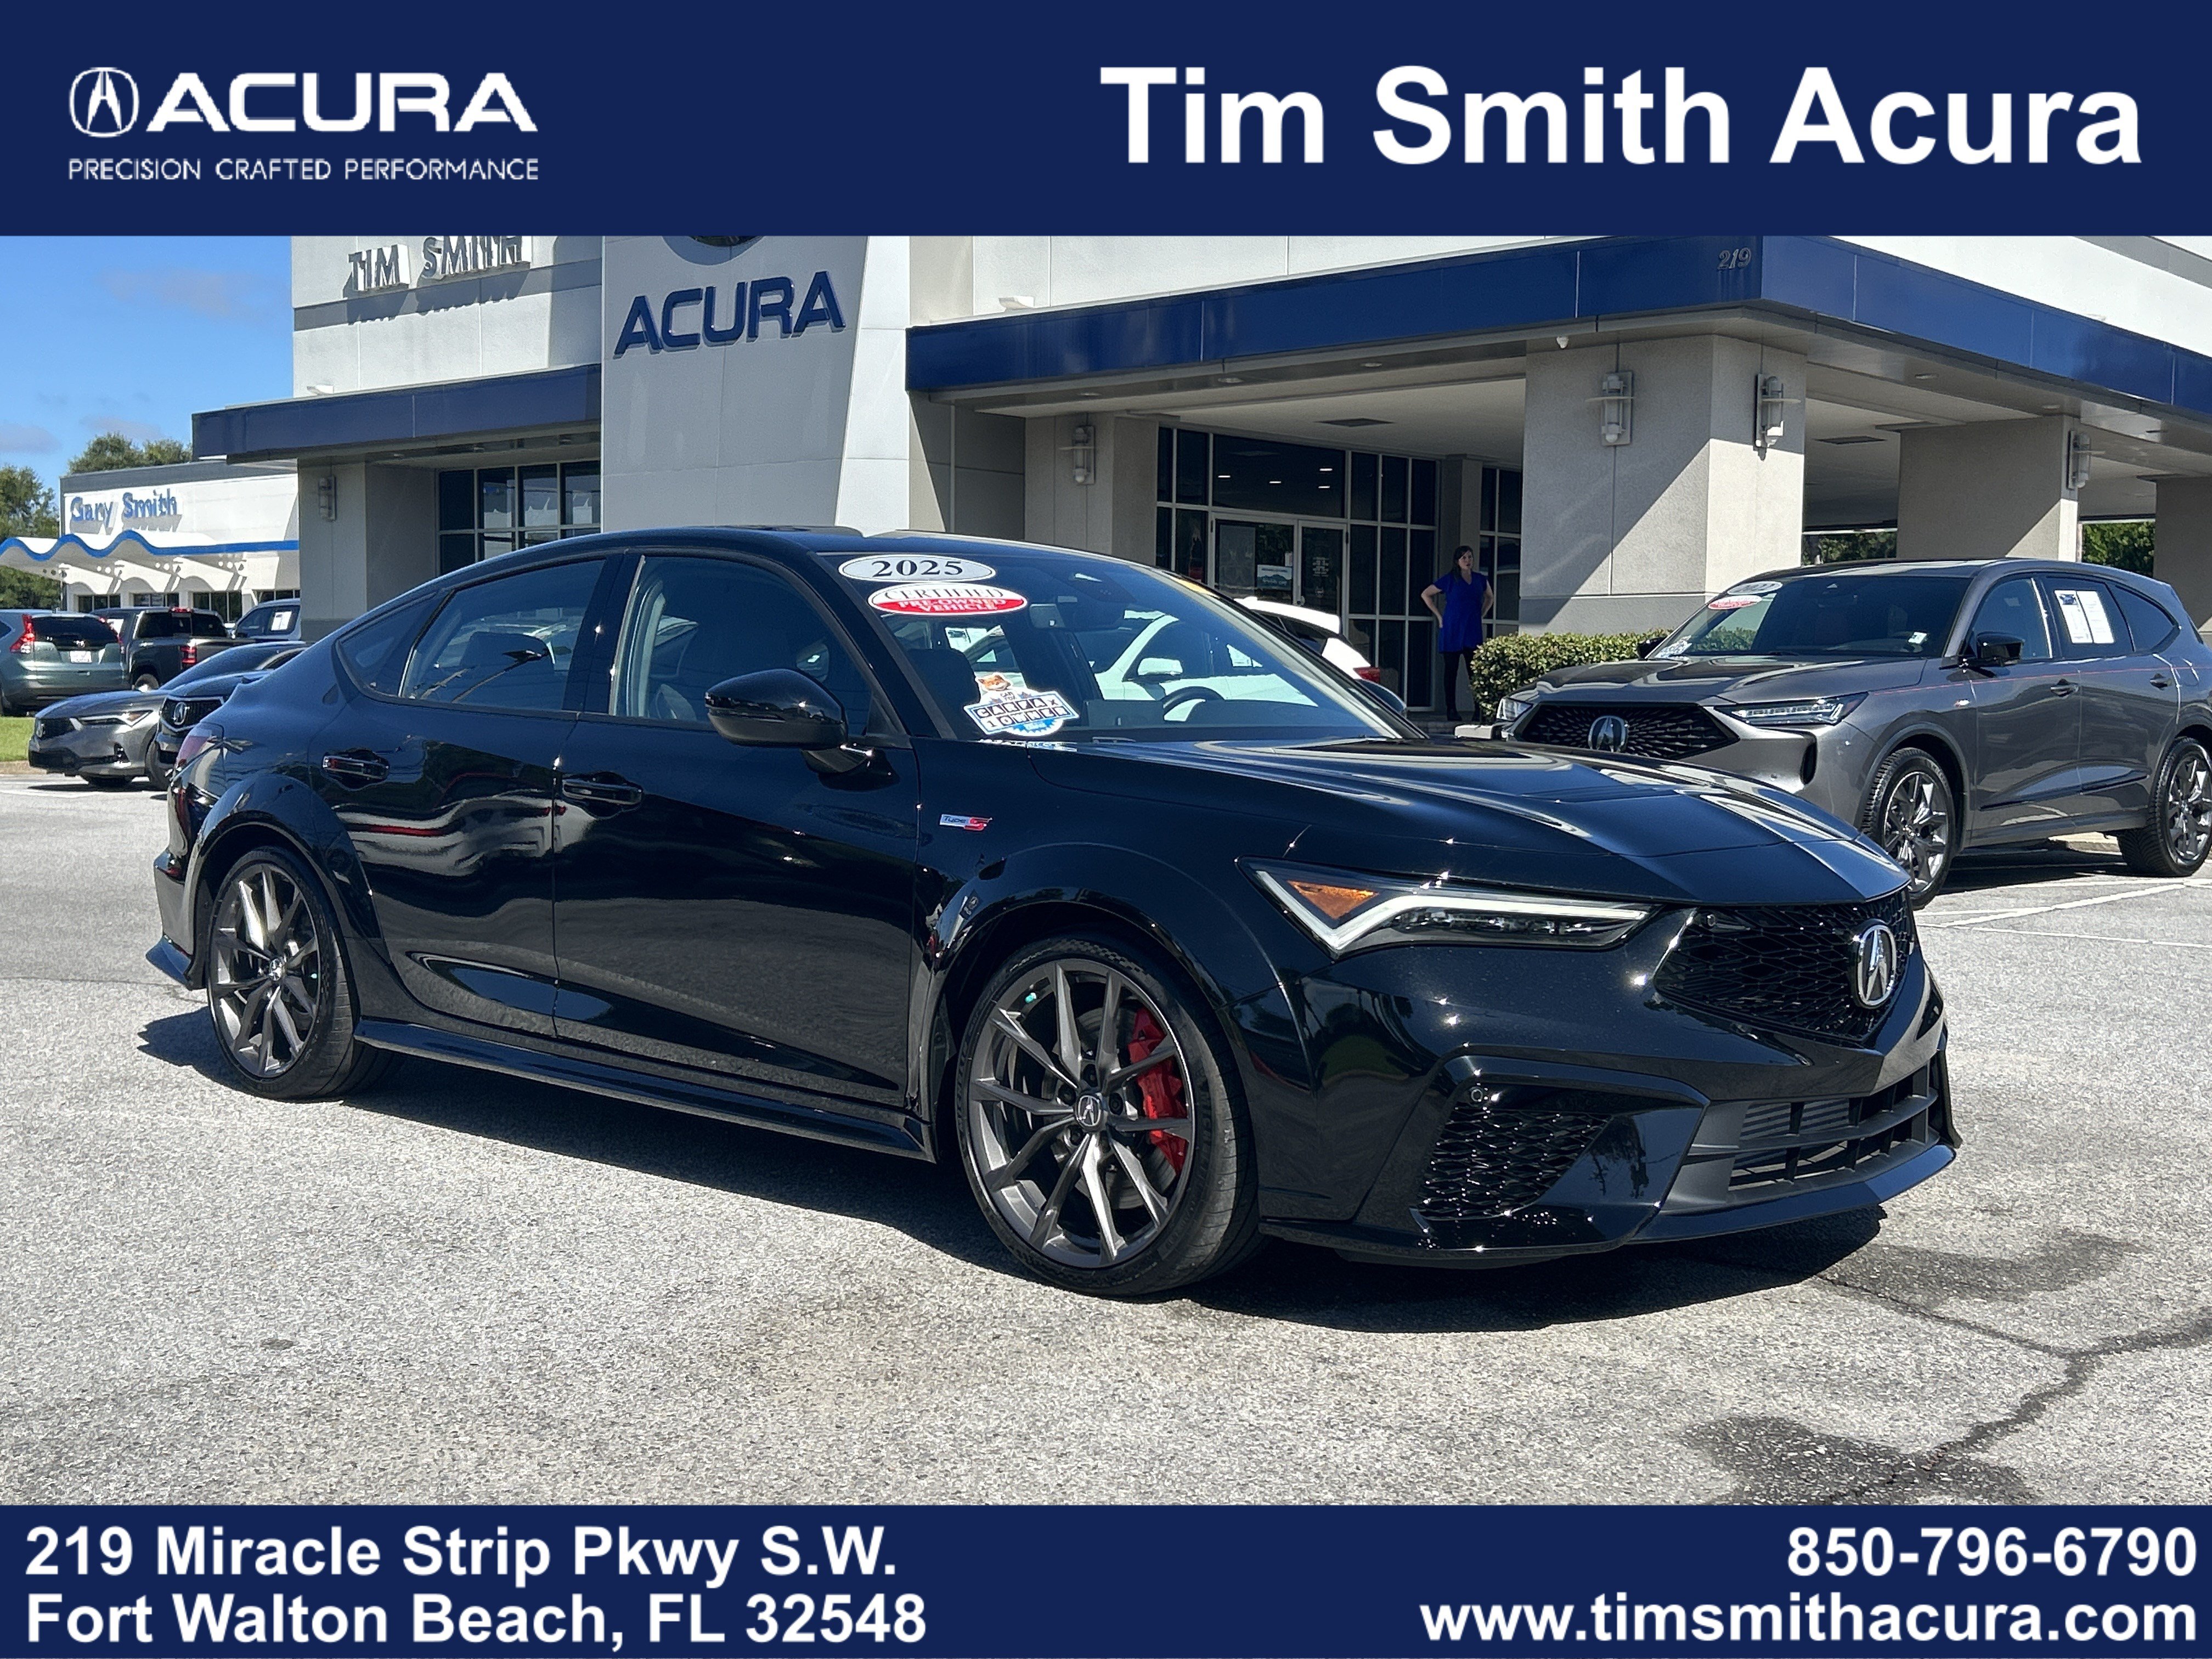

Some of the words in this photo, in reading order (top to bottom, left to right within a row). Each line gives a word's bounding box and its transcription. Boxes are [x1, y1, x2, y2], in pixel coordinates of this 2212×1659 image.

[348, 245, 409, 291] TIM
[1717, 247, 1751, 270] 219
[613, 271, 846, 359] ACURA
[70, 496, 117, 528] Gary
[123, 488, 177, 518] Smith
[871, 559, 963, 577] 2025
[884, 588, 1004, 600] CERTIFIED
[974, 698, 1058, 718] CARFAX
